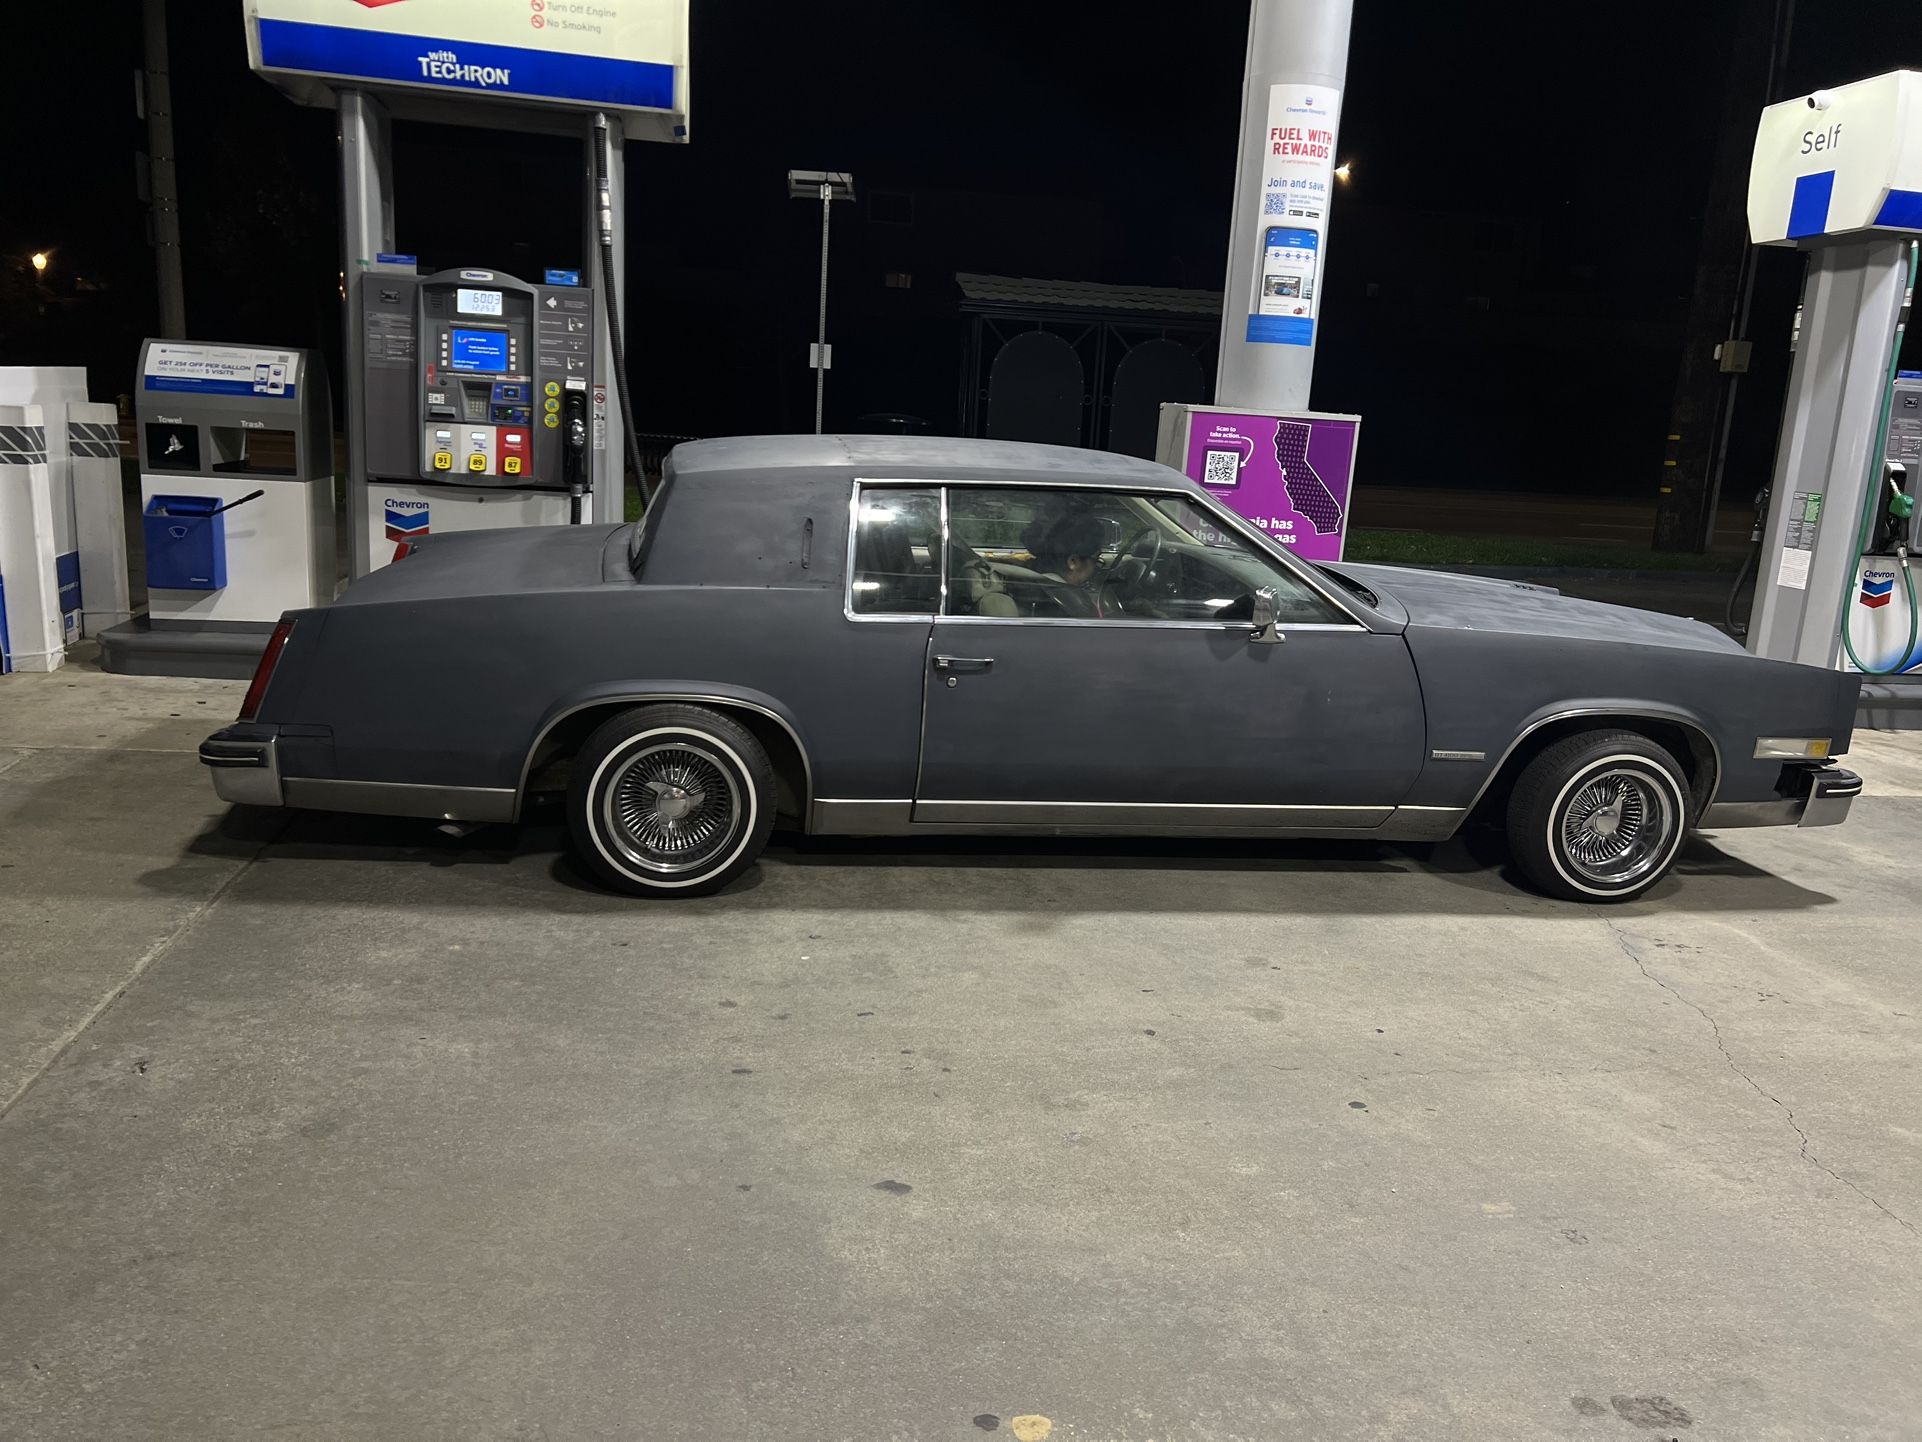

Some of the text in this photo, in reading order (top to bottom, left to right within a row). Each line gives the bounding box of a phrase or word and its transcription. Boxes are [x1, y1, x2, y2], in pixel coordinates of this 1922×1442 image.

[547, 2, 617, 19] Turn Off Engine
[547, 18, 602, 34] No Smoking
[428, 50, 457, 63] with
[417, 56, 510, 87] TECHRON
[1270, 127, 1333, 146] FUEL WITH
[1801, 123, 1842, 154] Self
[1272, 142, 1329, 159] REWARDS
[1267, 177, 1325, 192] Join and save.
[221, 363, 251, 371] GALLON
[157, 415, 183, 424] Towel
[240, 420, 265, 428] Trash
[437, 456, 448, 465] 91
[472, 458, 483, 467] 89
[507, 461, 518, 469] 87
[384, 498, 430, 510] Chevron
[1270, 517, 1294, 530] has
[1191, 529, 1216, 543] the
[1863, 569, 1895, 579] Chevron
